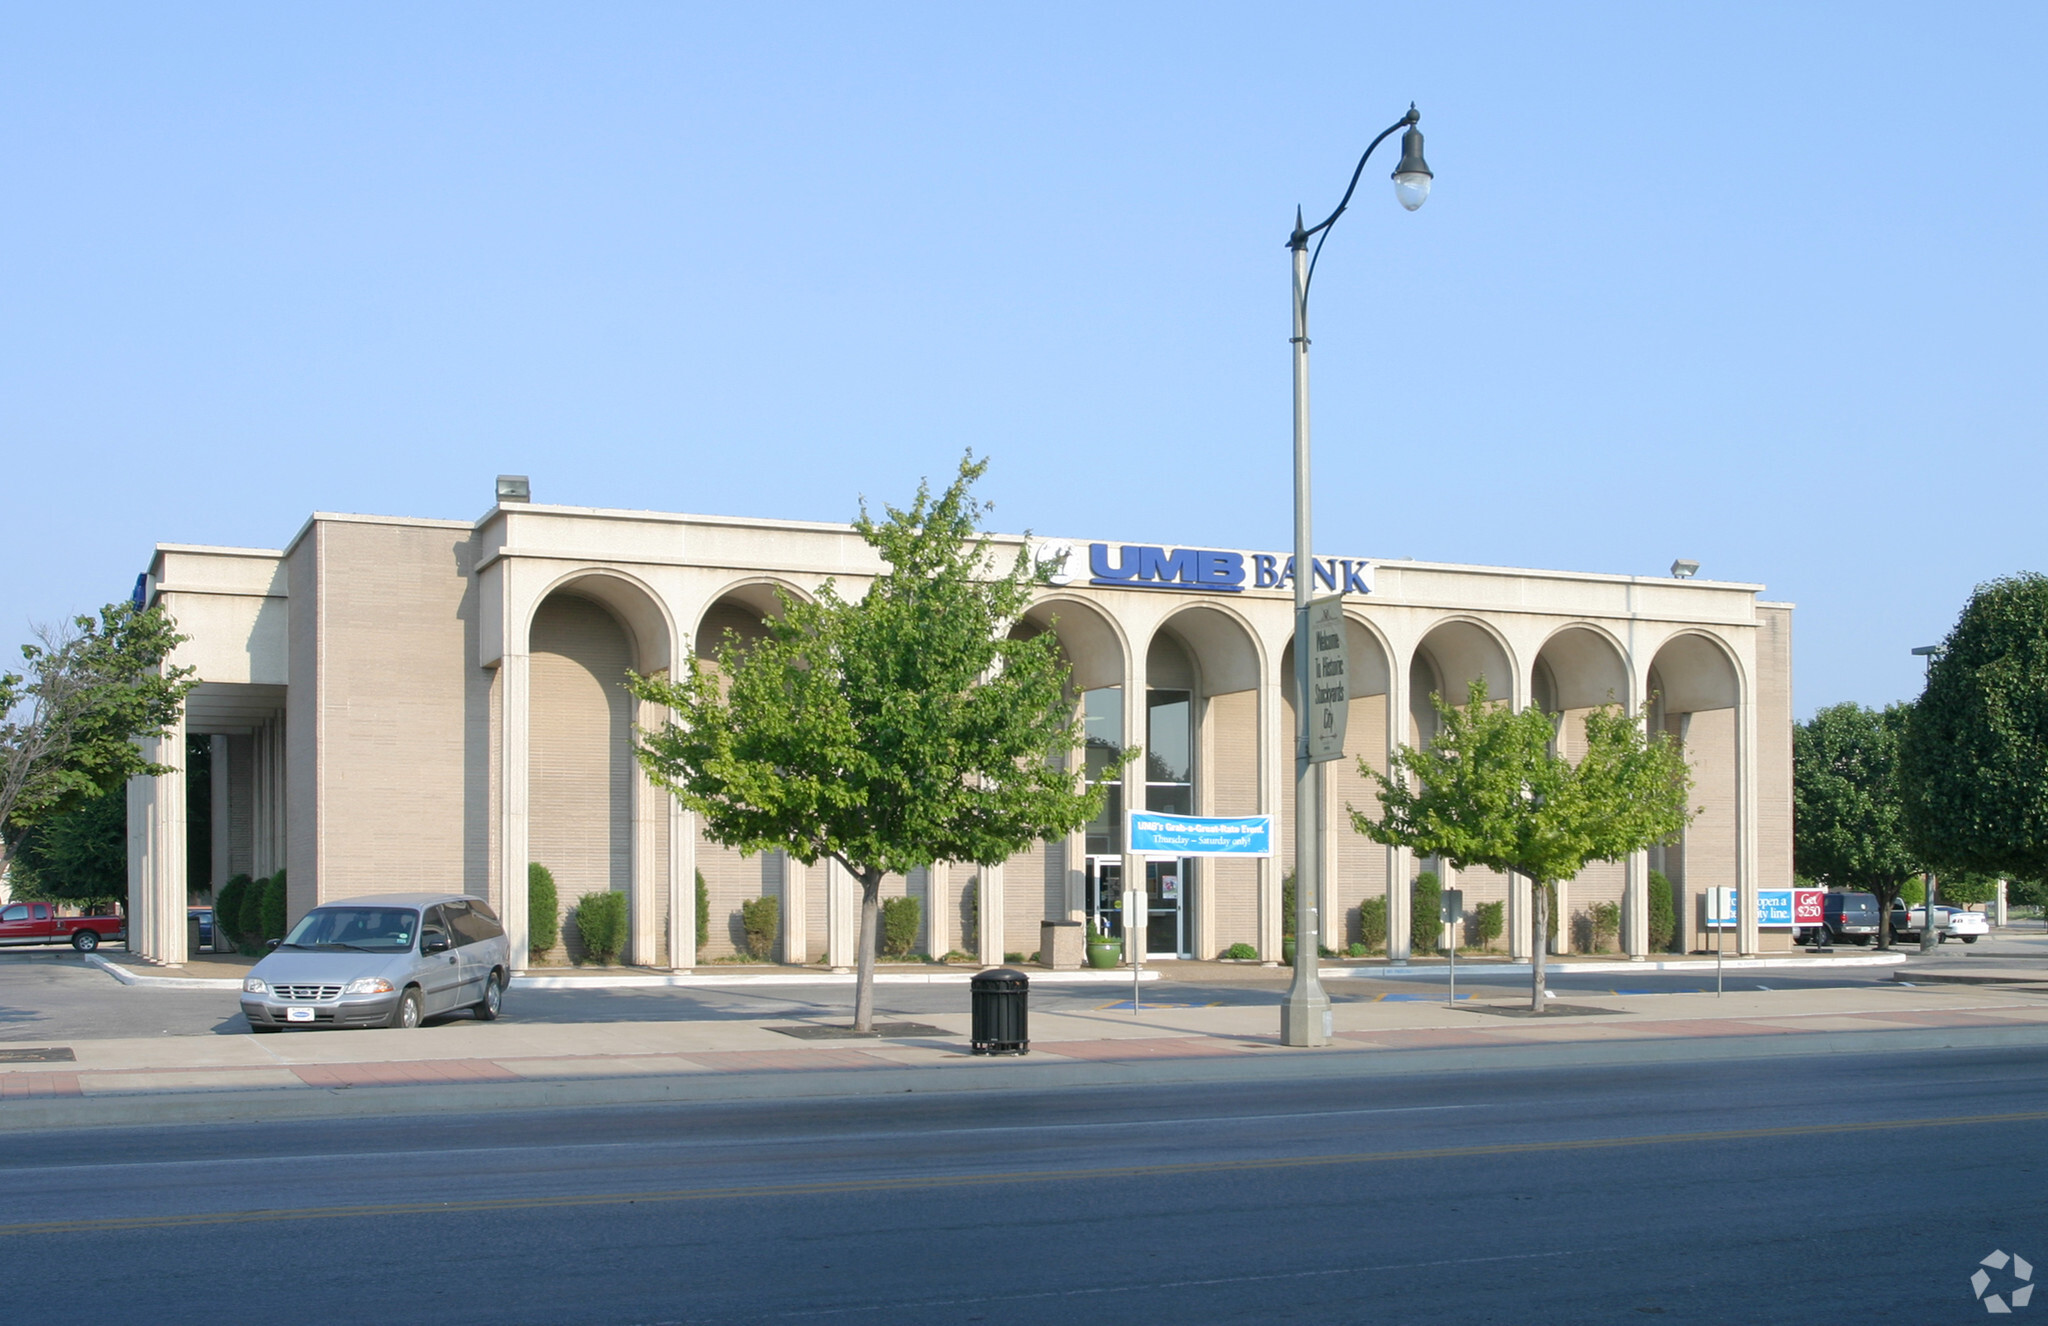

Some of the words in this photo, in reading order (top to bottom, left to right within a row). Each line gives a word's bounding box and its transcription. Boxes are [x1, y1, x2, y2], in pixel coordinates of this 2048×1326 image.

[1089, 543, 1246, 586] UMB
[1252, 554, 1371, 594] BANK
[1316, 630, 1340, 652] Welcome
[1322, 655, 1344, 677] Historic
[1315, 681, 1344, 707] Stockyards
[1323, 708, 1334, 733] City
[1153, 834, 1190, 846] Thursday
[1198, 835, 1230, 847] Saturday
[1780, 898, 1788, 906] a
[1800, 893, 1818, 906] Get
[1797, 905, 1821, 917] $250
